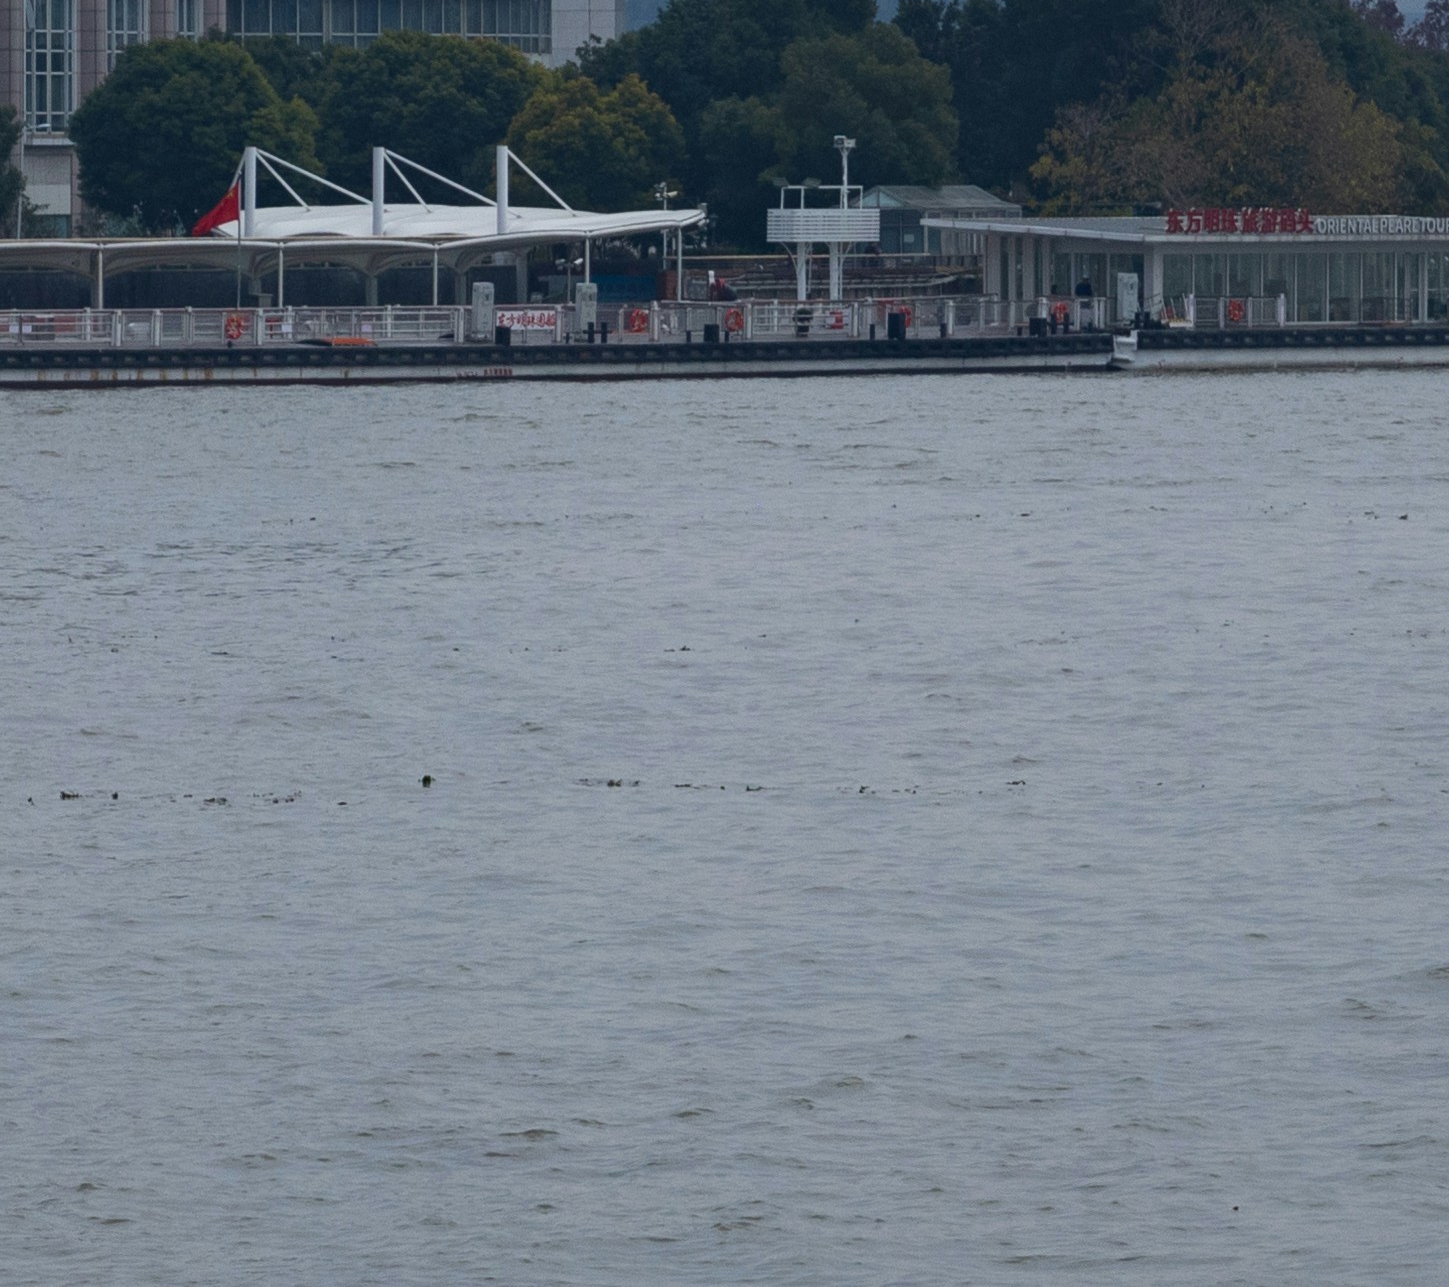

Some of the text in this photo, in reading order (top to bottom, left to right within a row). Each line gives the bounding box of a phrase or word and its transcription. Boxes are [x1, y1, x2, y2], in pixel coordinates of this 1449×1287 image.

[1165, 207, 1315, 235] 东方明珠旅游码头
[1317, 217, 1378, 234] ORIENTAL
